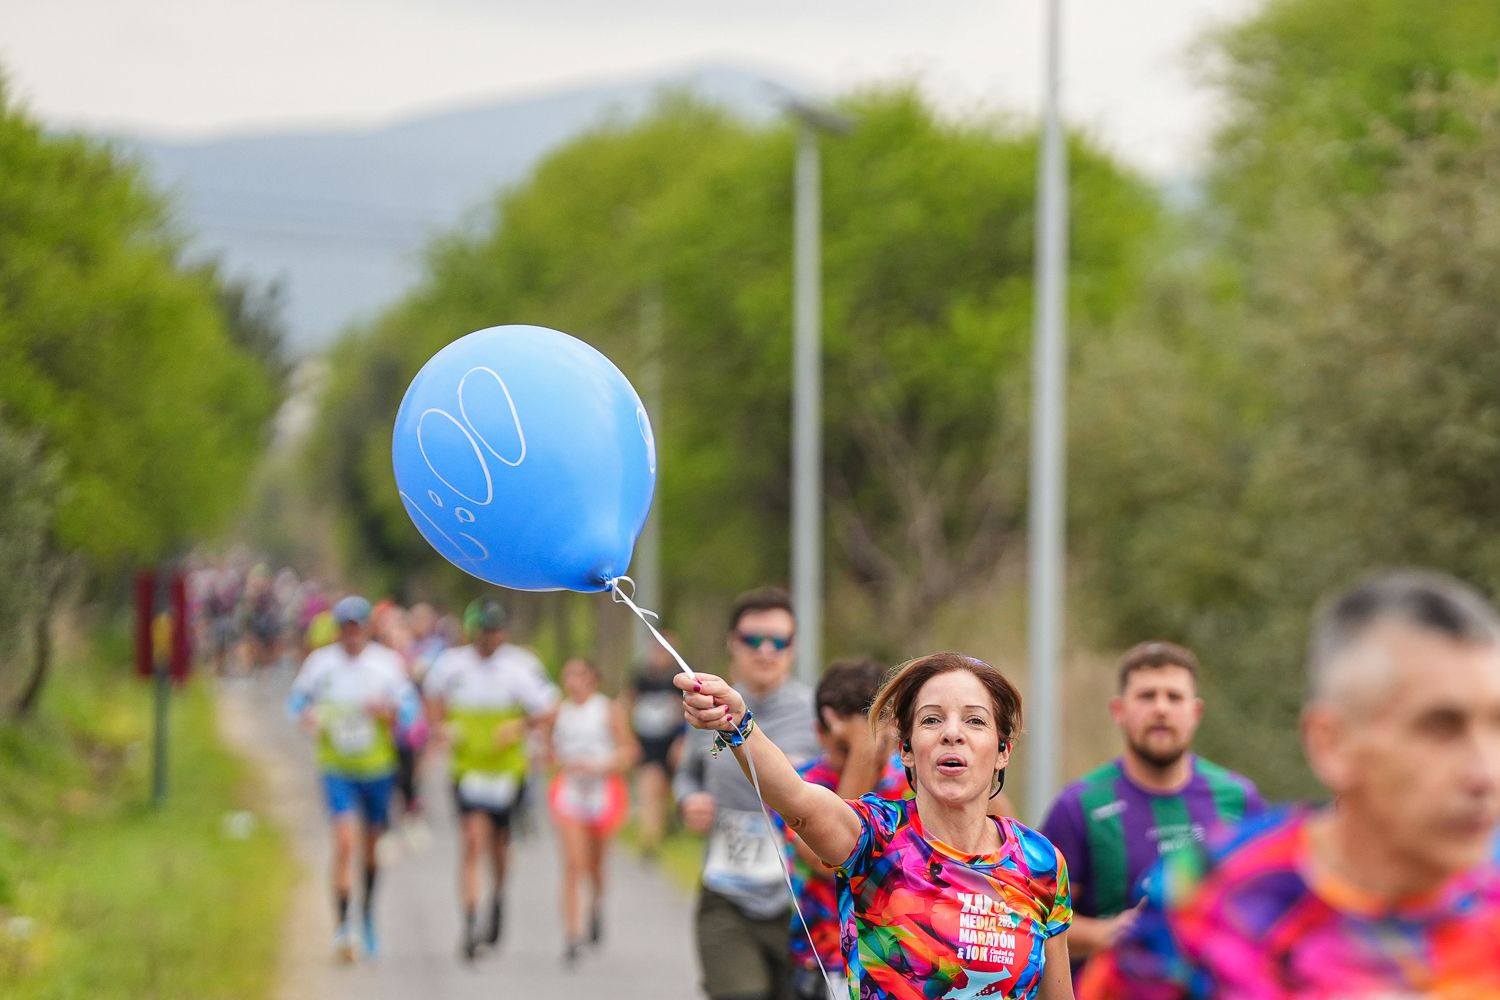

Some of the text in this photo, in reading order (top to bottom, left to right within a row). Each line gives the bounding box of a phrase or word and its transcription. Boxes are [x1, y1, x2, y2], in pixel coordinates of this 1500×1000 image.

[960, 913, 996, 932] MEDIA
[959, 928, 1016, 949] MARATÓN
[957, 945, 988, 961] & 10K
[989, 955, 1014, 965] LUCENA
